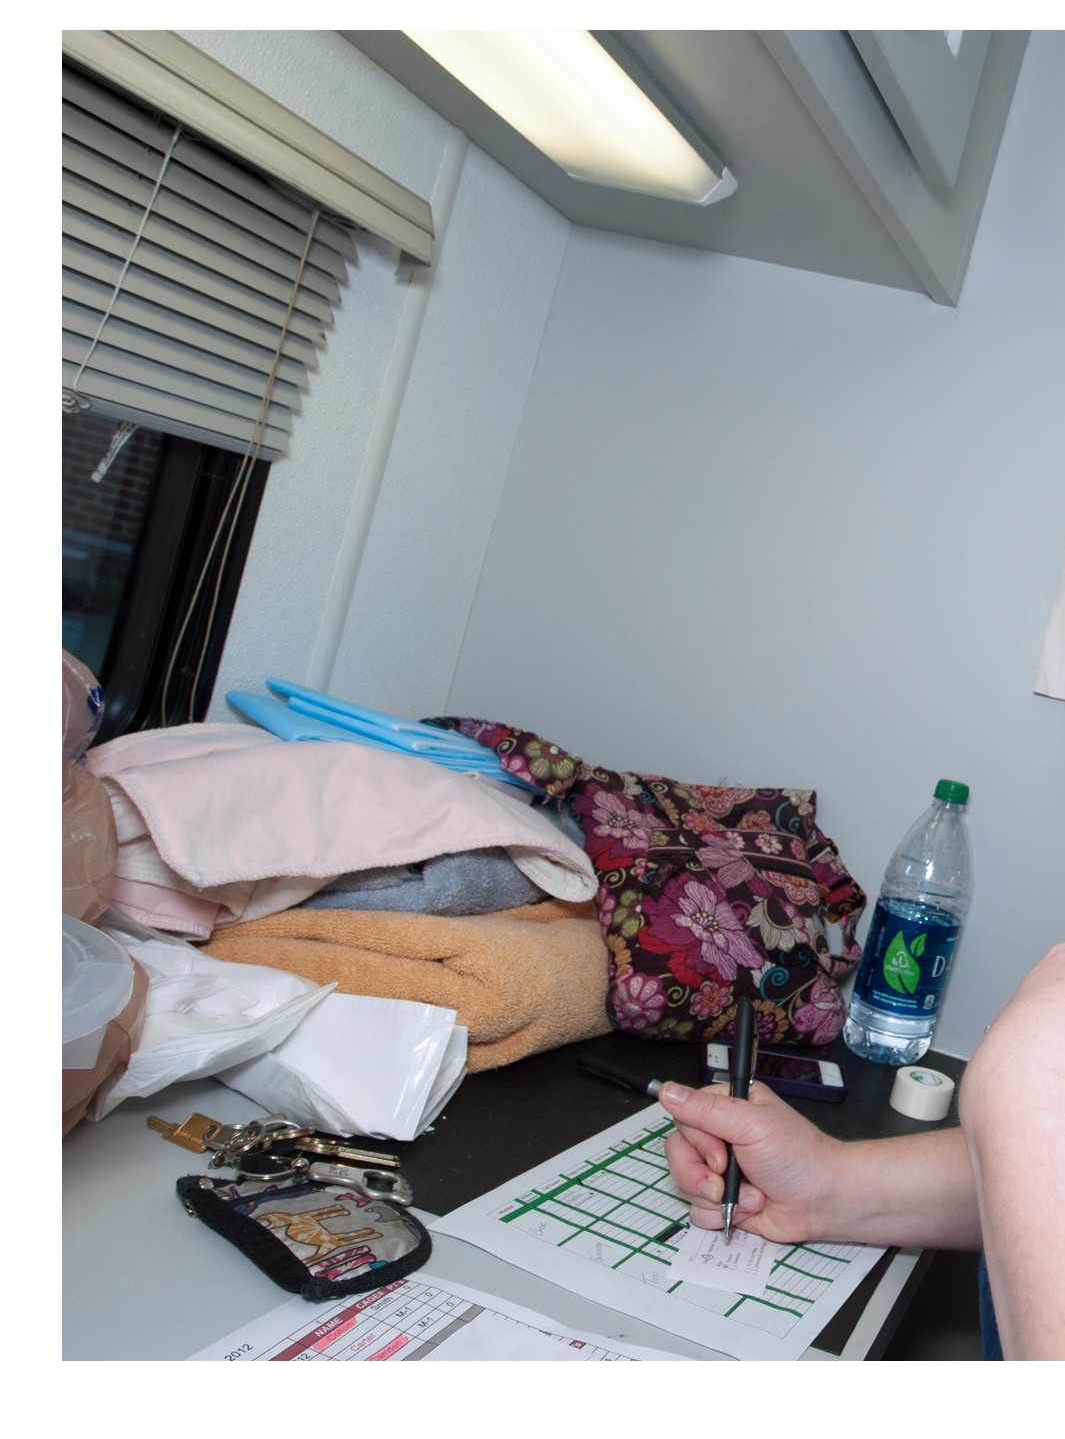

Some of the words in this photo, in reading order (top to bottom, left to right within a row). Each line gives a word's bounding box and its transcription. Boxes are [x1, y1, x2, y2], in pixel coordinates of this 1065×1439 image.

[314, 1317, 343, 1337] NAME
[326, 1322, 356, 1341] Colton
[370, 1296, 394, 1312] Smith
[418, 1317, 434, 1329] M-1
[350, 1333, 376, 1353] Carter
[396, 1307, 412, 1319] M-1
[224, 1343, 254, 1361] 2012
